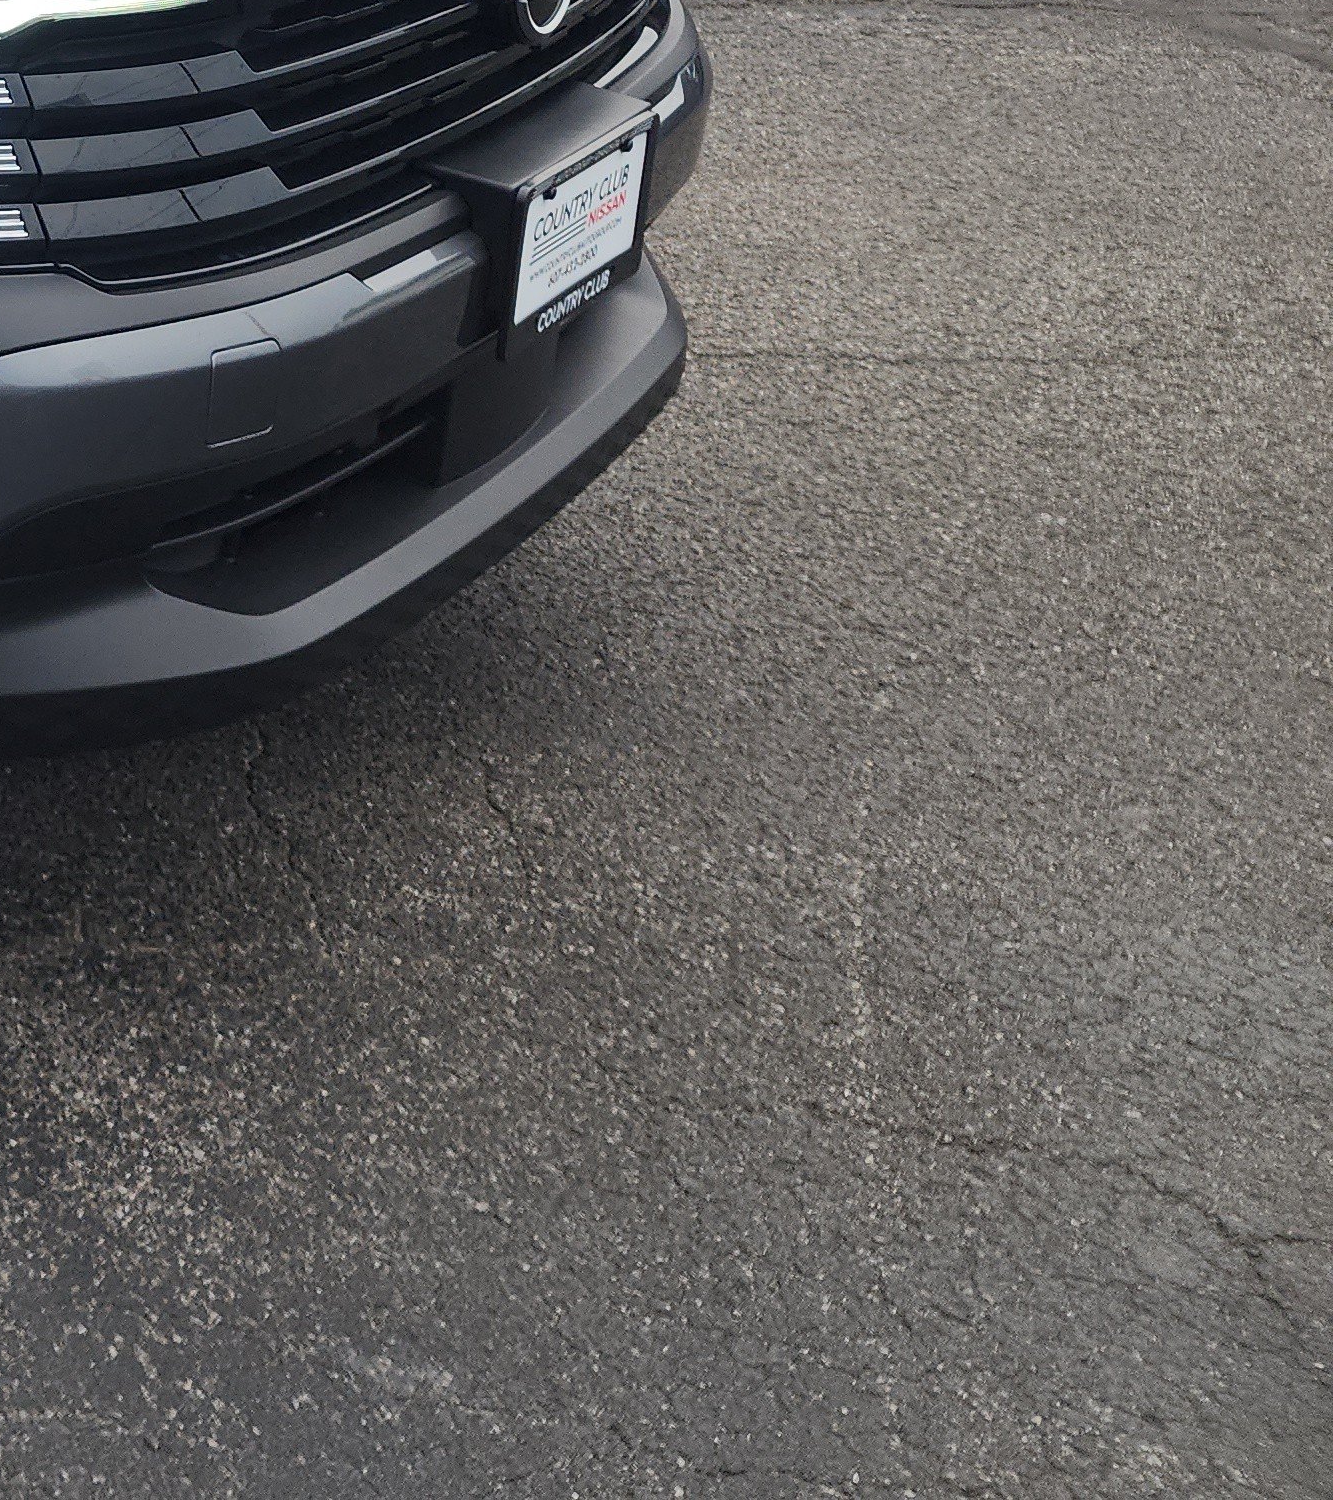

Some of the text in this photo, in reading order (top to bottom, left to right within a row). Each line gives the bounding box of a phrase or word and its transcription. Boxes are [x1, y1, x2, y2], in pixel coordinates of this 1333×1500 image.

[533, 164, 630, 242] COUNTRY CLUB
[587, 190, 628, 227] NISSAN
[537, 269, 611, 333] COUNTRY CLUB
